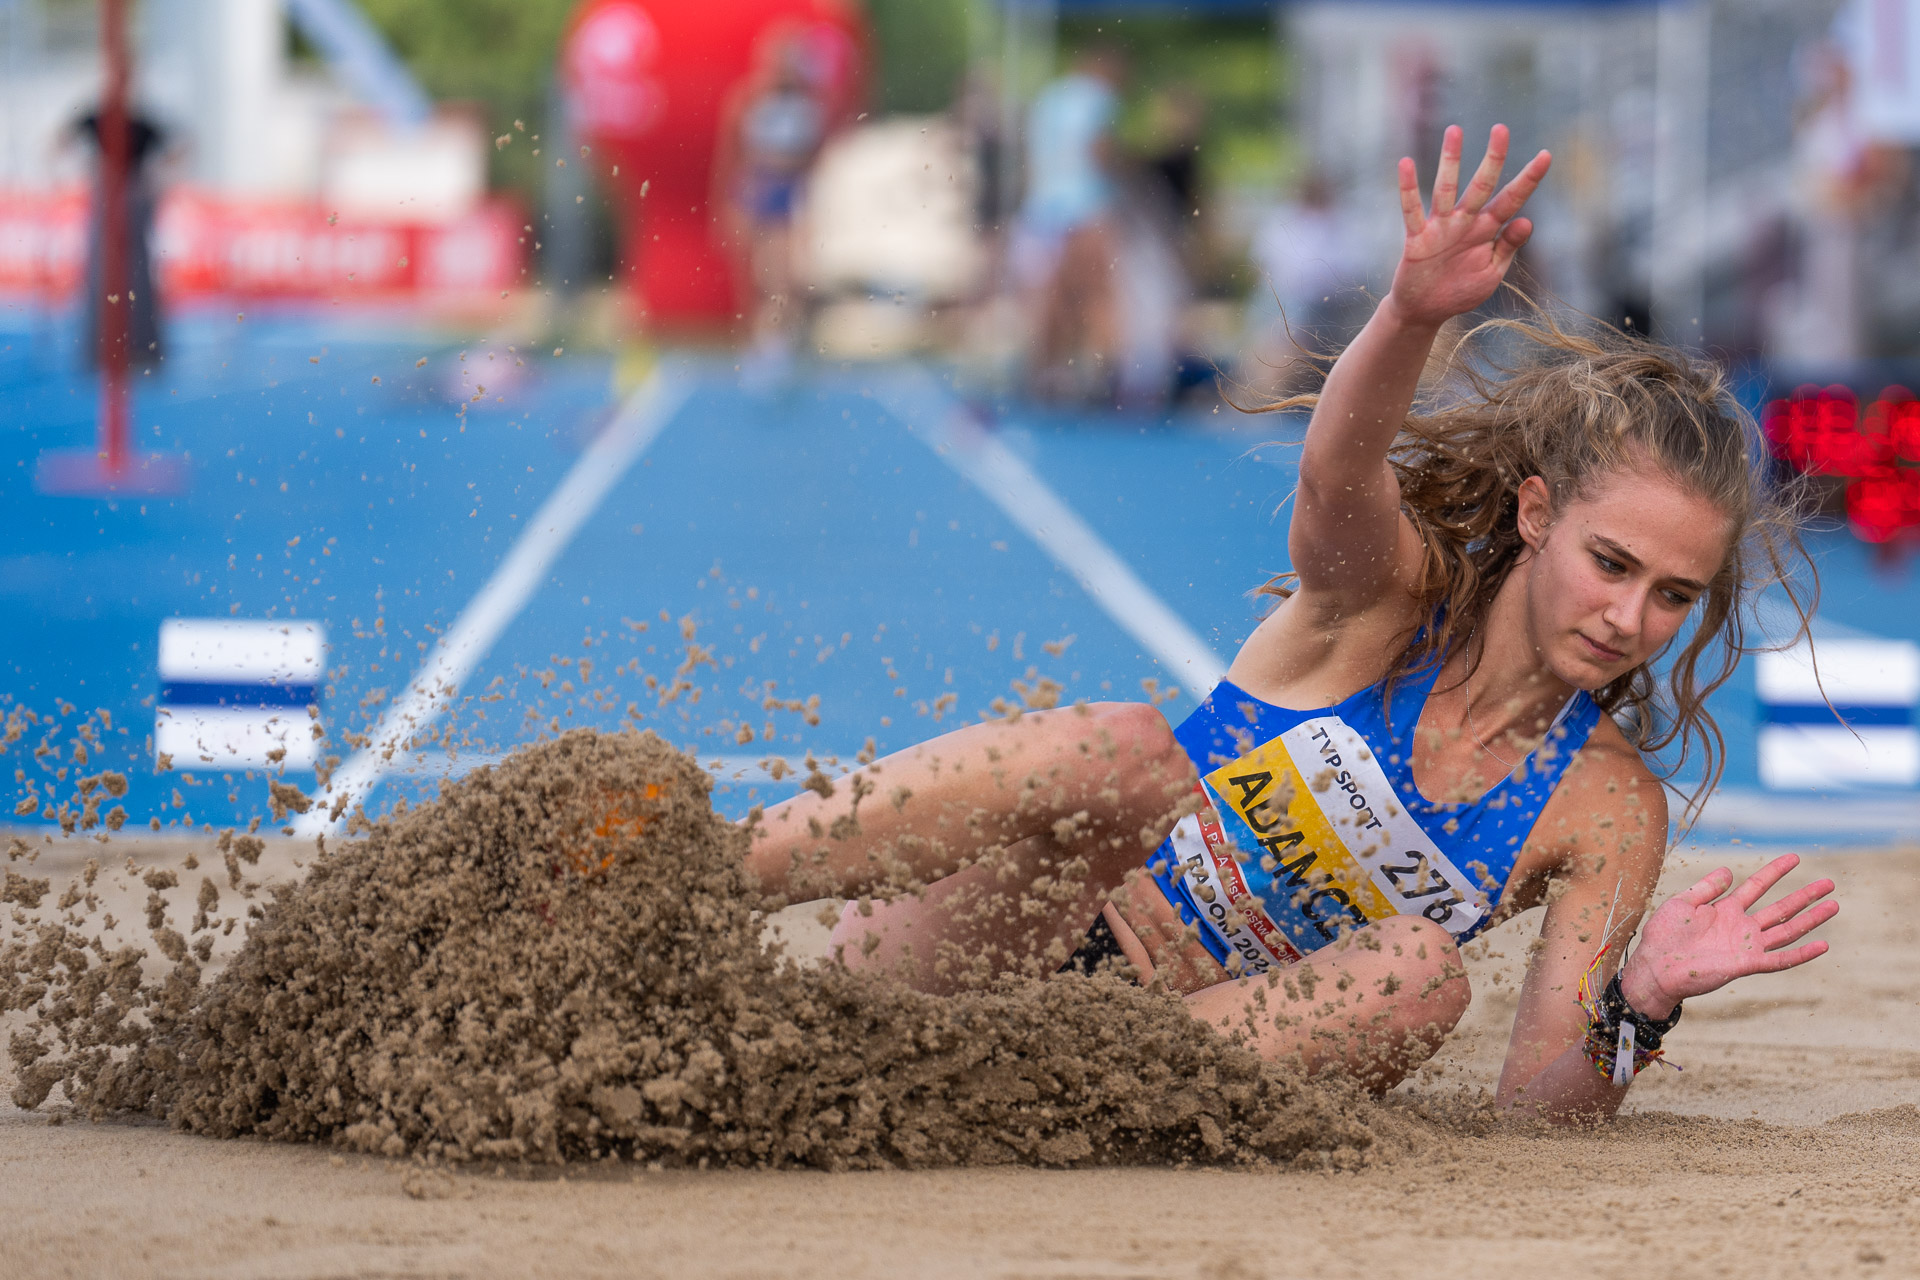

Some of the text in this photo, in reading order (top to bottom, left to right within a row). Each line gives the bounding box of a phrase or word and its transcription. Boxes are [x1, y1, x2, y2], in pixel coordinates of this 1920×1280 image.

[1311, 727, 1383, 831] TVP SPORT
[1228, 770, 1370, 942] ADAMCZ
[1380, 850, 1466, 925] 276
[1186, 853, 1270, 974] RADOM 202
